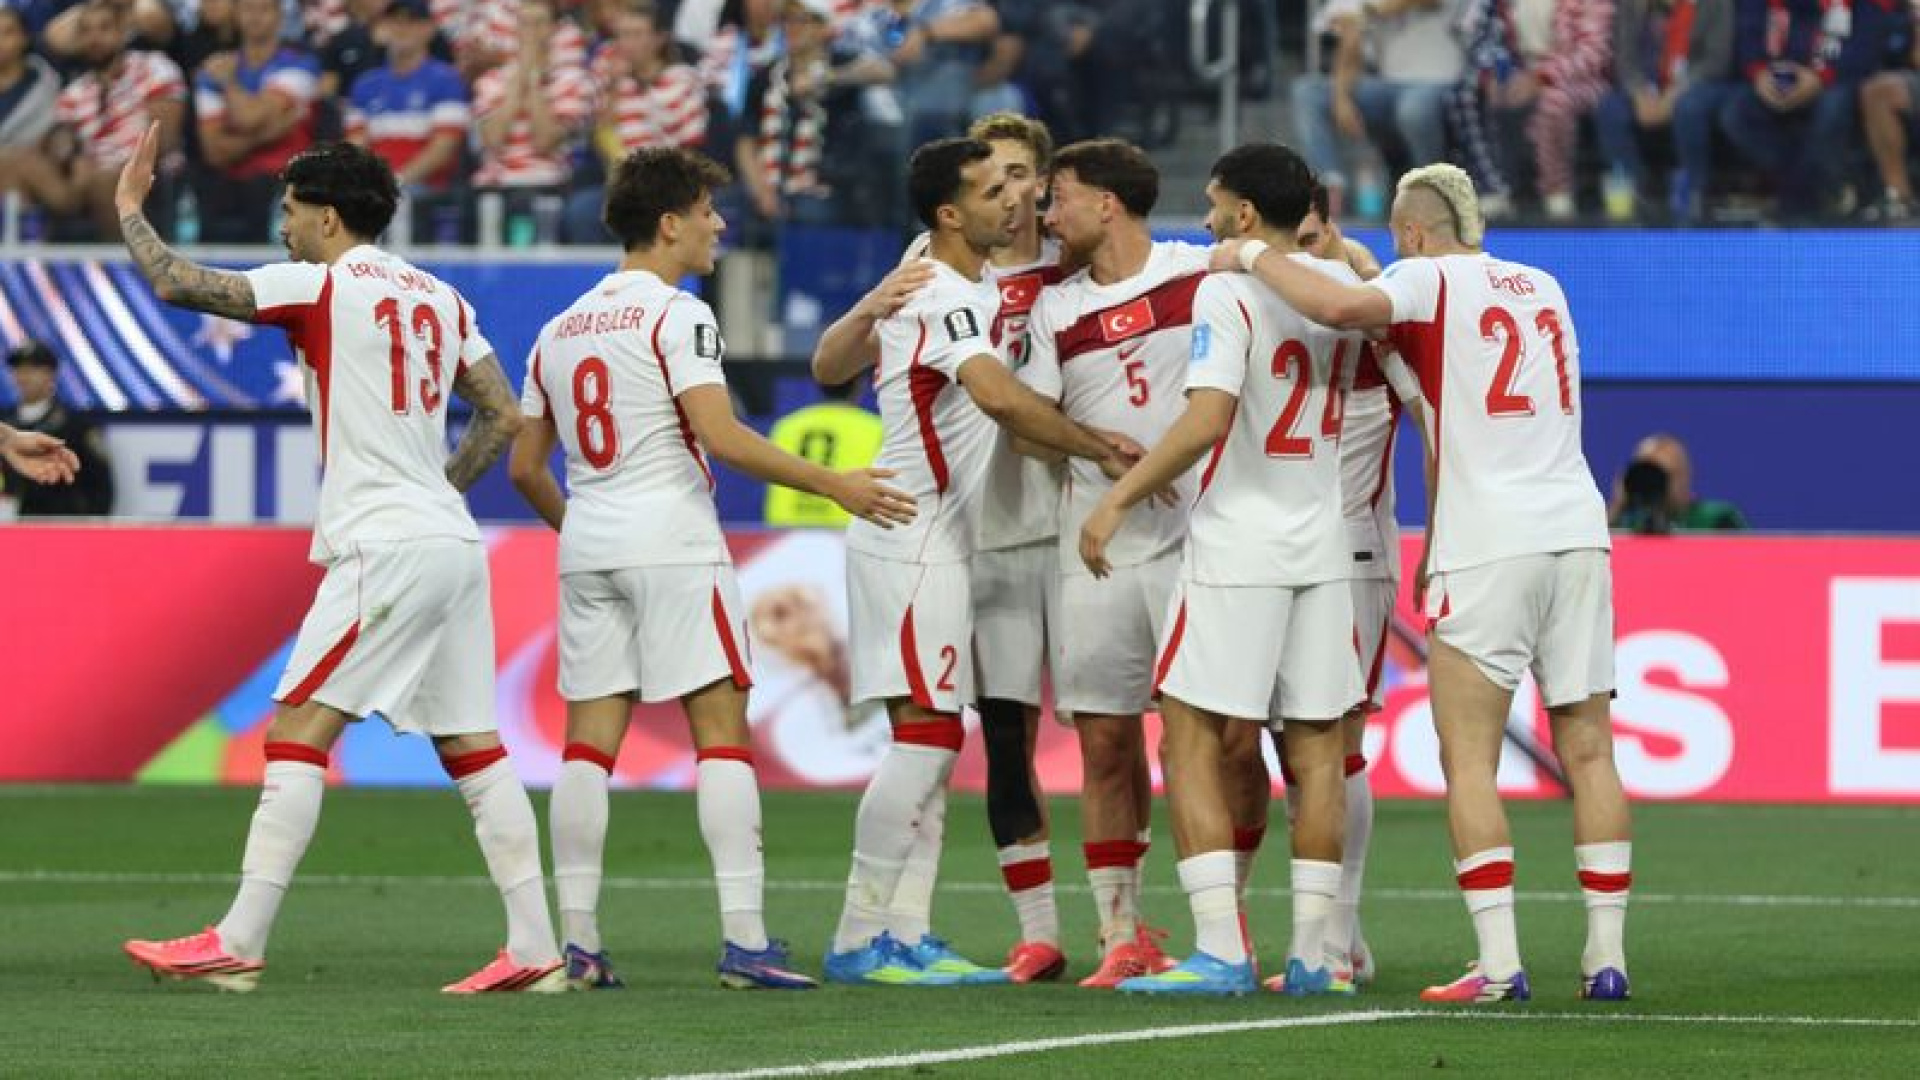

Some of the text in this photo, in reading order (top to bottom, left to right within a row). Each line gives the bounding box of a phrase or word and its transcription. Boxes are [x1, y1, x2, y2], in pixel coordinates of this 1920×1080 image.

[375, 297, 441, 415] 13
[1126, 360, 1150, 409] 5
[1264, 338, 1346, 458] 24
[1480, 306, 1575, 416] 21
[572, 357, 620, 471] 8
[936, 644, 958, 692] 2
